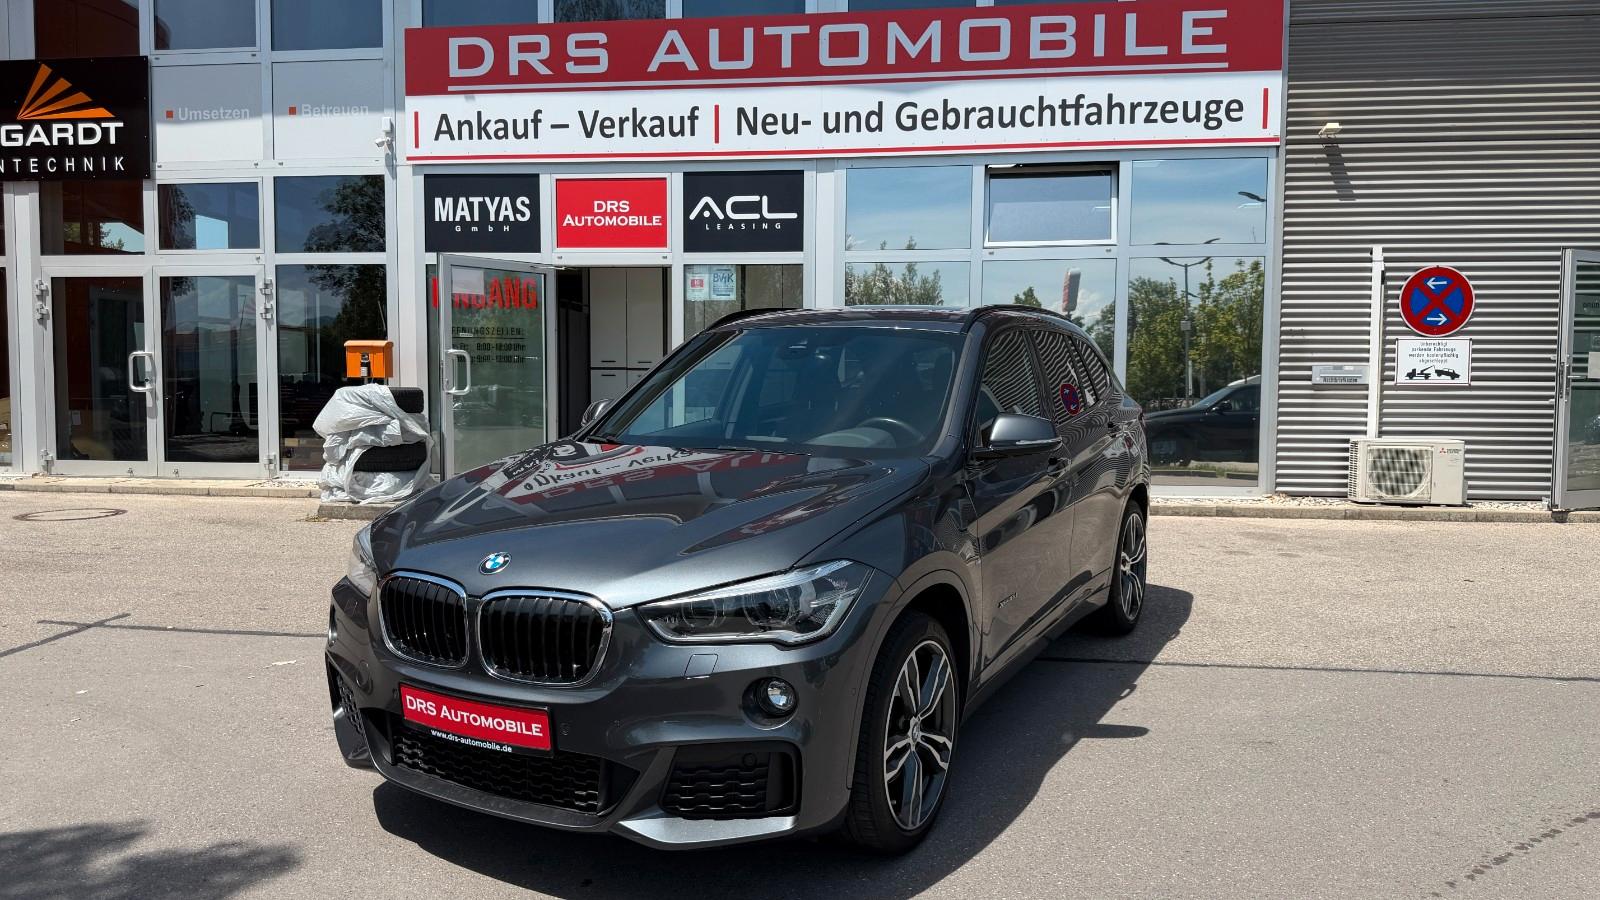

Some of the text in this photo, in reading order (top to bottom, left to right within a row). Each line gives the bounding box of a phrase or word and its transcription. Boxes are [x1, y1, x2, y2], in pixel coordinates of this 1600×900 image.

[448, 9, 1228, 78] DRS AUTOMOBILE
[178, 107, 250, 121] Umsetzen
[301, 103, 369, 118] Betreuen
[434, 109, 543, 141] Ankauf
[578, 105, 700, 139] Verkauf
[736, 106, 812, 136] Neu-
[823, 101, 884, 135] und
[895, 93, 1245, 132] Gebrauchtfahrzeuge
[0, 122, 124, 147] GARDT
[434, 196, 531, 222] MATYAS
[593, 200, 630, 213] DRS
[689, 195, 798, 220] ACL
[562, 213, 662, 227] AUTOMOBILE
[705, 222, 781, 231] LEASING
[405, 694, 543, 737] DRS AUTOMOBILE
[430, 728, 513, 753] www.drs-automobile.de
